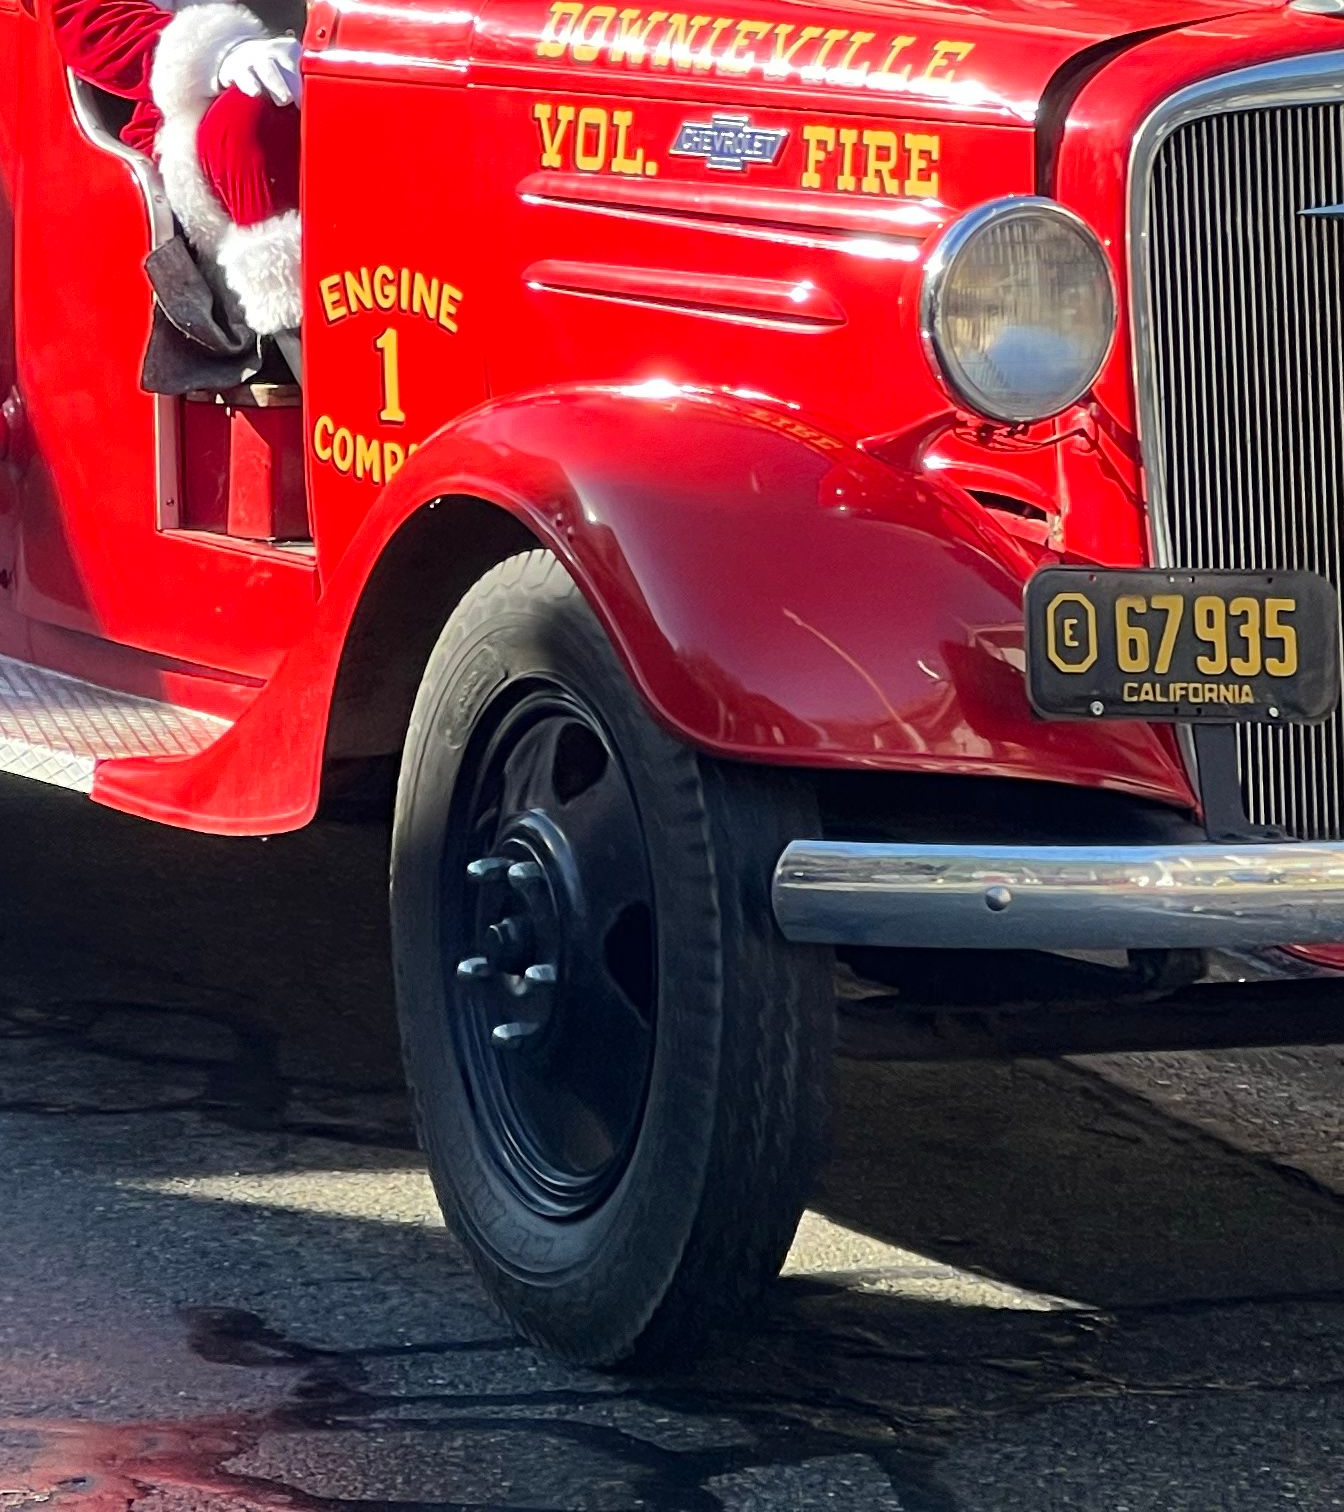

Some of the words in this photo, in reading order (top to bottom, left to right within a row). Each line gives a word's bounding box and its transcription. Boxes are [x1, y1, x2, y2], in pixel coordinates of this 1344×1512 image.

[535, 0, 976, 89] DOWNIEVILLE
[532, 102, 660, 178] VOL.
[800, 124, 941, 199] FIRE
[679, 126, 777, 157] CHEVROLET
[318, 265, 465, 336] ENGINE
[375, 327, 406, 425] 1
[1063, 618, 1080, 647] E
[1114, 593, 1298, 678] 67935
[1122, 681, 1255, 705] CALIFORNIA
